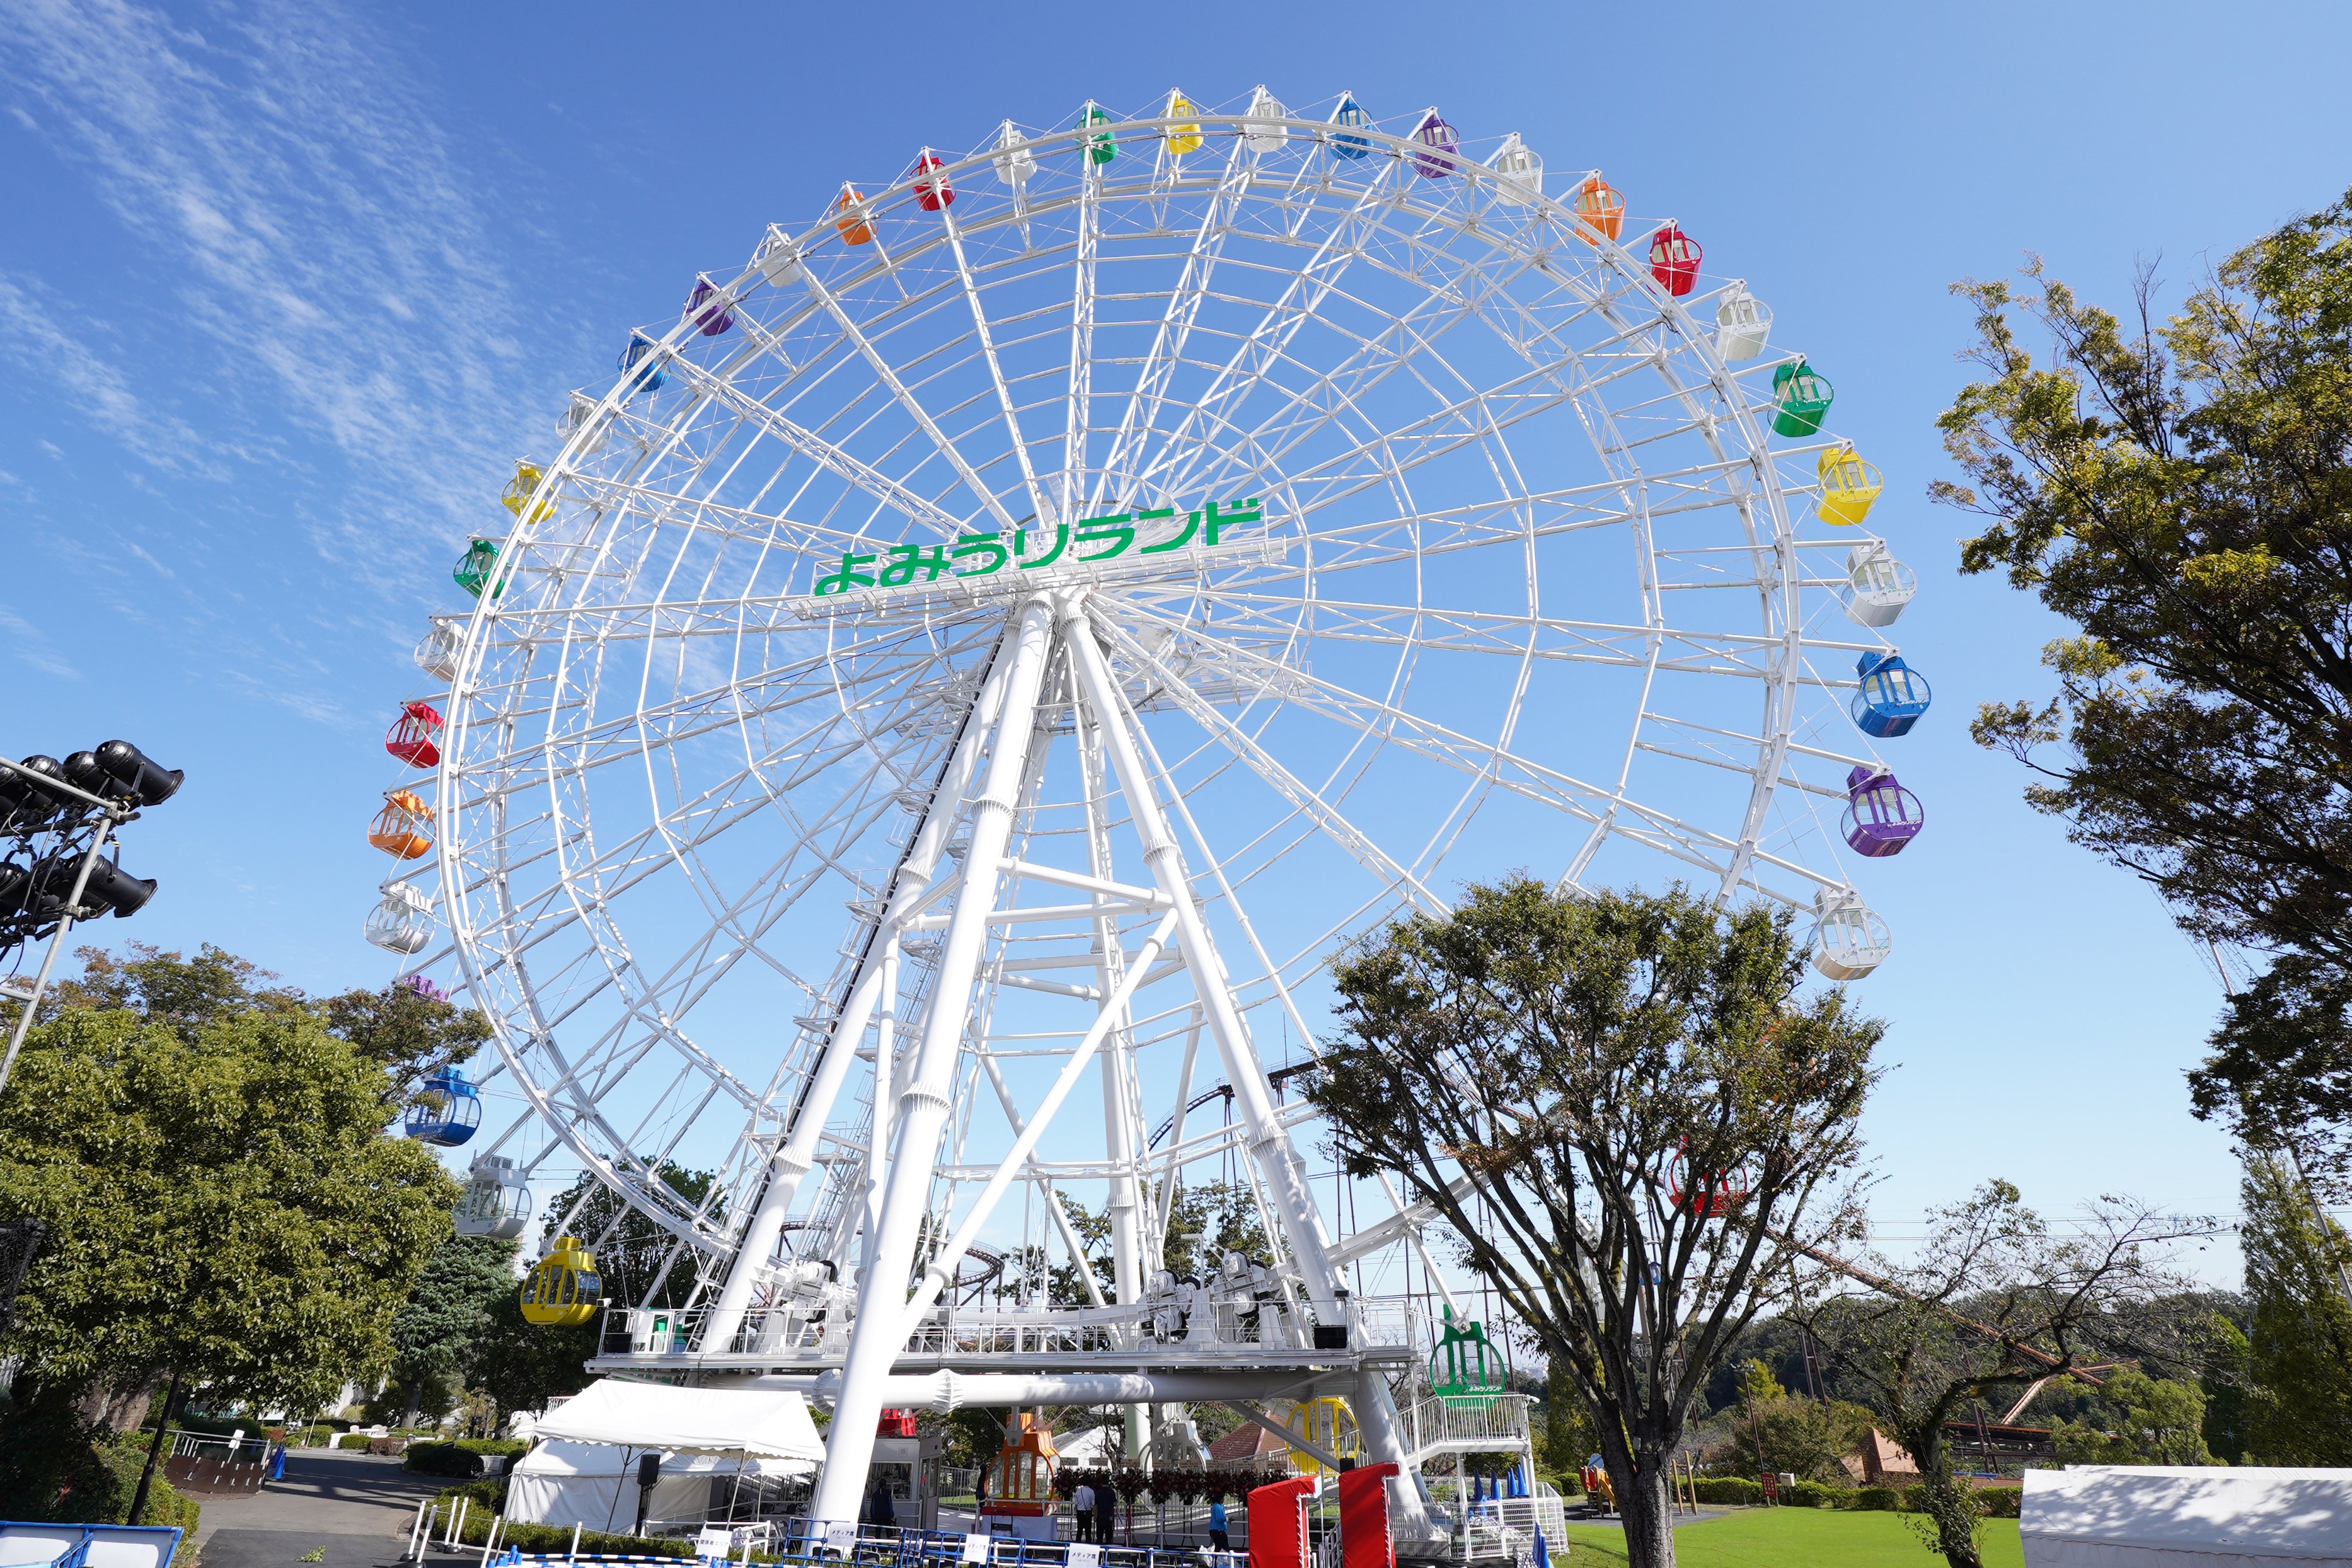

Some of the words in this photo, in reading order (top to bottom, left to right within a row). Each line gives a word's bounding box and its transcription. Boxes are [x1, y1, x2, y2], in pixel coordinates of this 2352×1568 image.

[816, 498, 1260, 596] よみうりランド
